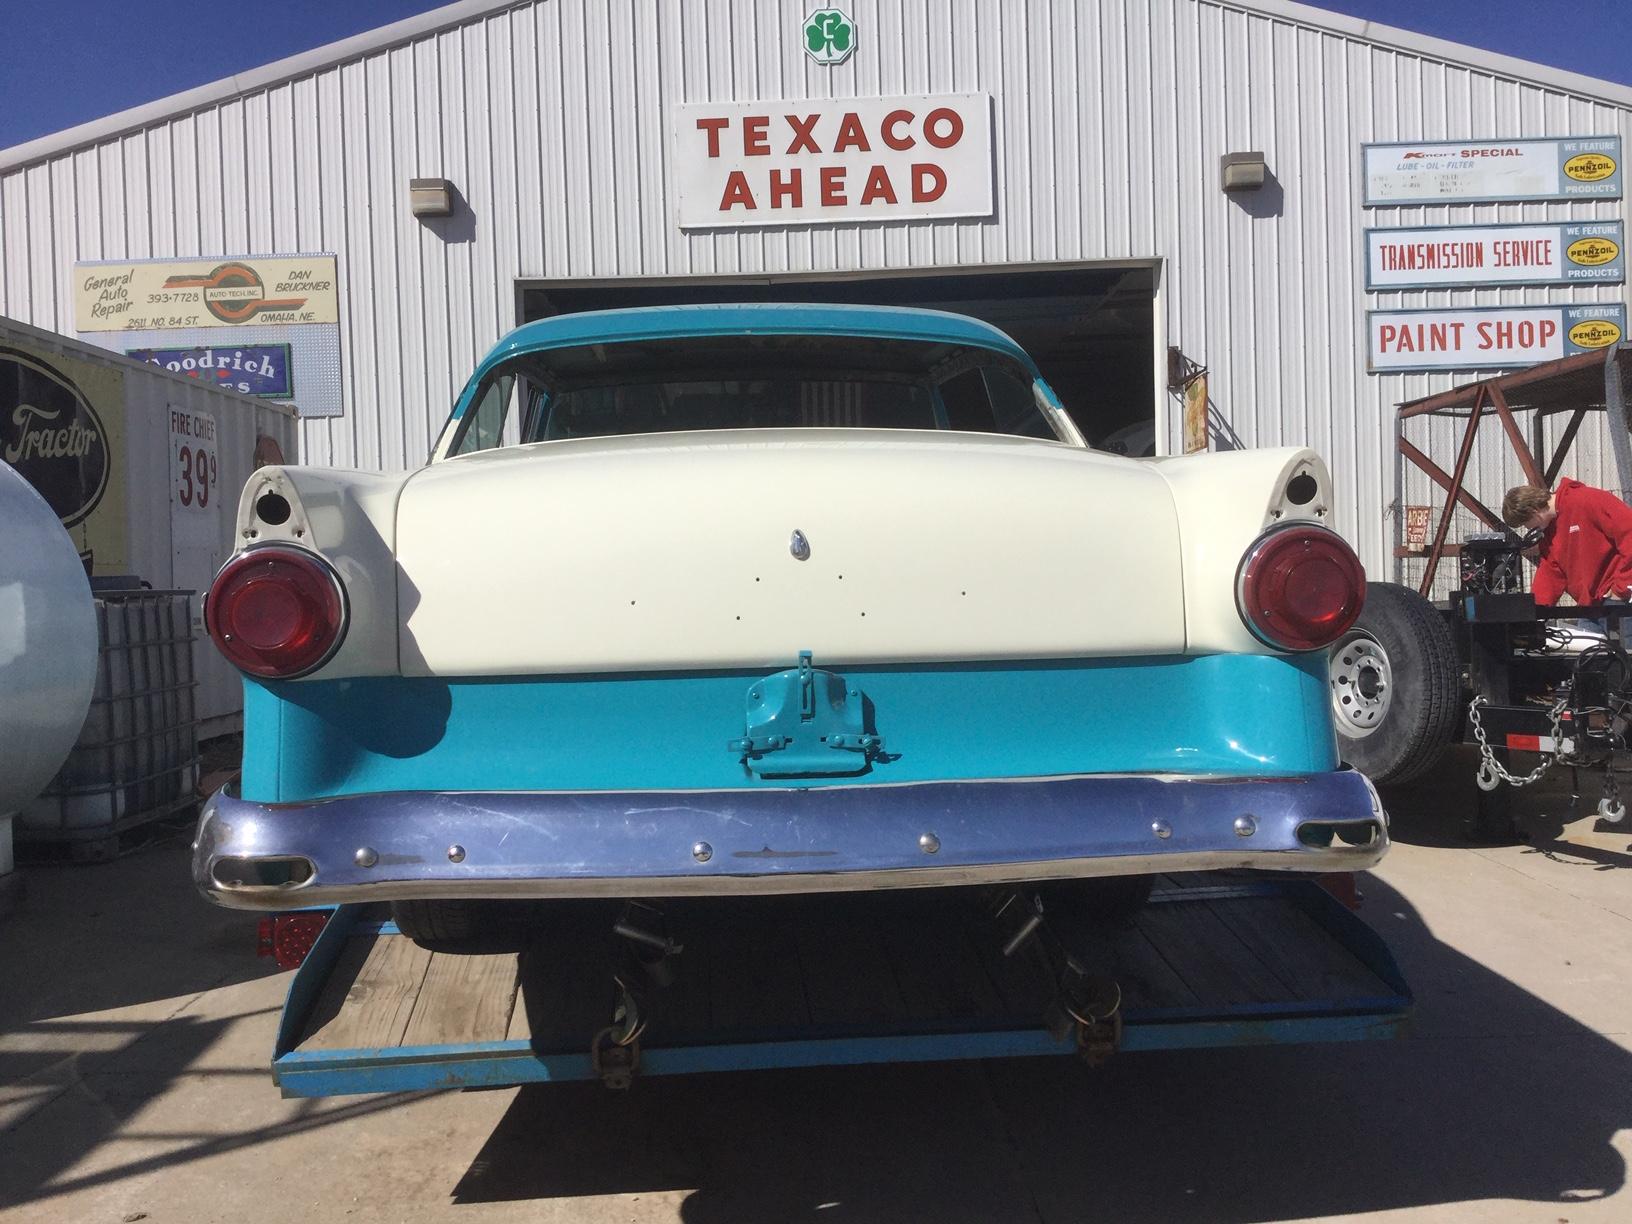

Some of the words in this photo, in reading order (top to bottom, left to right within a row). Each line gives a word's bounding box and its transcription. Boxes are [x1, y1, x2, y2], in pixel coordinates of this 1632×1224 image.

[696, 107, 964, 158] TEXACO
[1564, 142, 1577, 151] WE
[1580, 141, 1615, 150] FEATURE
[1460, 148, 1523, 158] SPECIAL
[1568, 162, 1612, 172] PENNZOIL
[719, 163, 947, 211] AHEAD
[1565, 184, 1616, 193] PRODUCTS
[1566, 227, 1580, 236] WE
[1582, 226, 1618, 235] FEATURE
[1380, 242, 1484, 271] TRANSMISSION
[1493, 240, 1552, 267] SERVICE
[1571, 246, 1614, 257] PENNZOIL
[288, 270, 312, 280] DAN
[1568, 268, 1620, 278] PRODUCTS
[84, 268, 134, 292] General
[275, 281, 330, 292] BRUCKNER
[99, 285, 128, 302] Auto
[91, 298, 134, 320] Repair
[1568, 310, 1582, 318] WE
[1584, 308, 1620, 318] FEATURE
[168, 316, 182, 326] 84
[185, 316, 199, 326] ST.
[1380, 322, 1465, 353] PAINT
[1476, 320, 1556, 350] SHOP
[1572, 330, 1616, 340] PENNZOIL
[145, 350, 275, 378] oodrich
[172, 410, 192, 436] FIRE
[194, 416, 215, 441] CHIEF
[5, 404, 97, 464] Tractor
